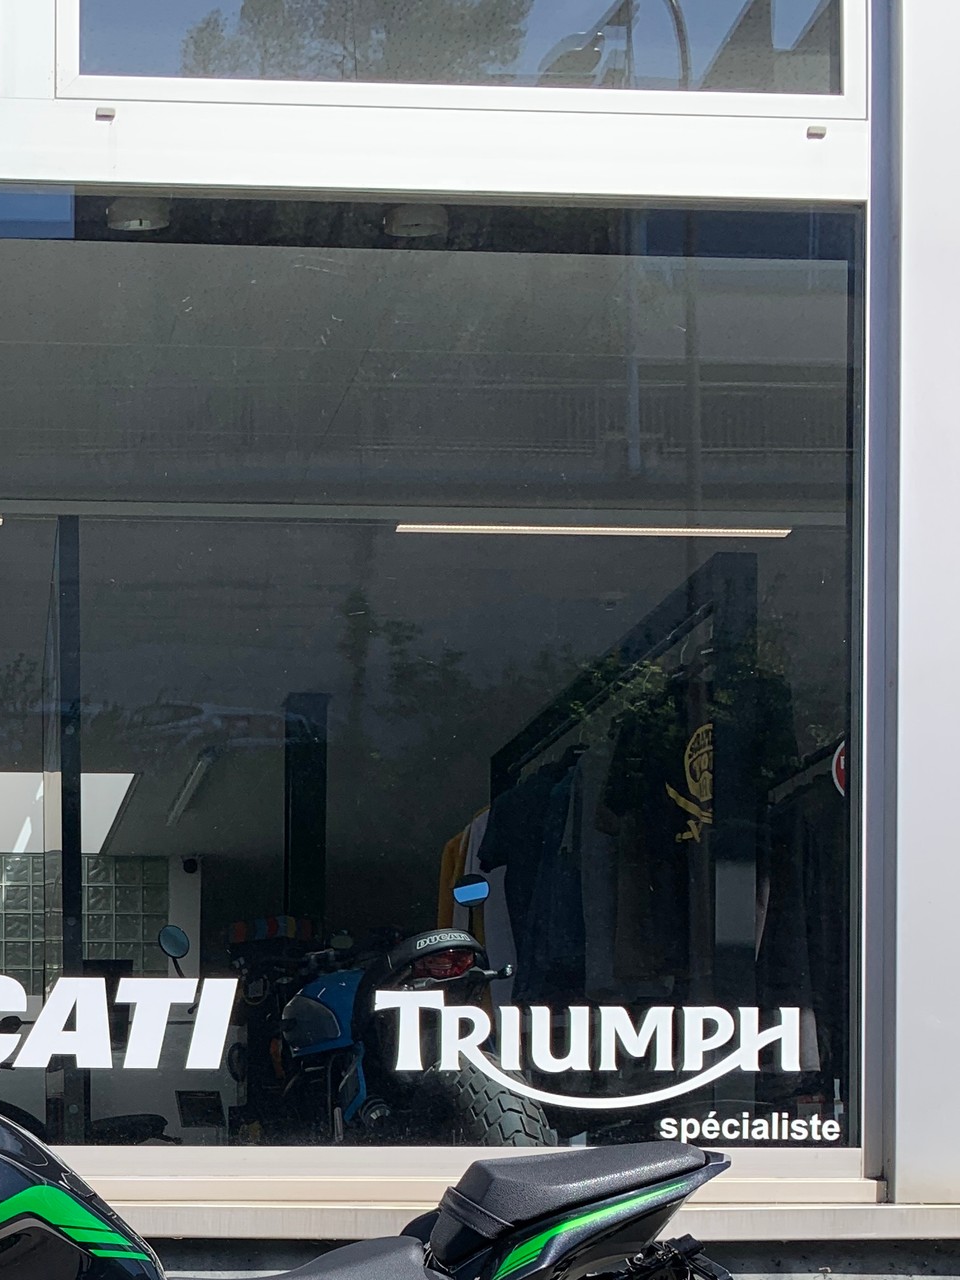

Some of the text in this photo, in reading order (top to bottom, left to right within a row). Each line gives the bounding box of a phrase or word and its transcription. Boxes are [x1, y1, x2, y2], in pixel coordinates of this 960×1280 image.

[416, 932, 471, 950] DUCATI
[375, 990, 802, 1108] TRIUMPH
[659, 1110, 842, 1147] spécialiste
